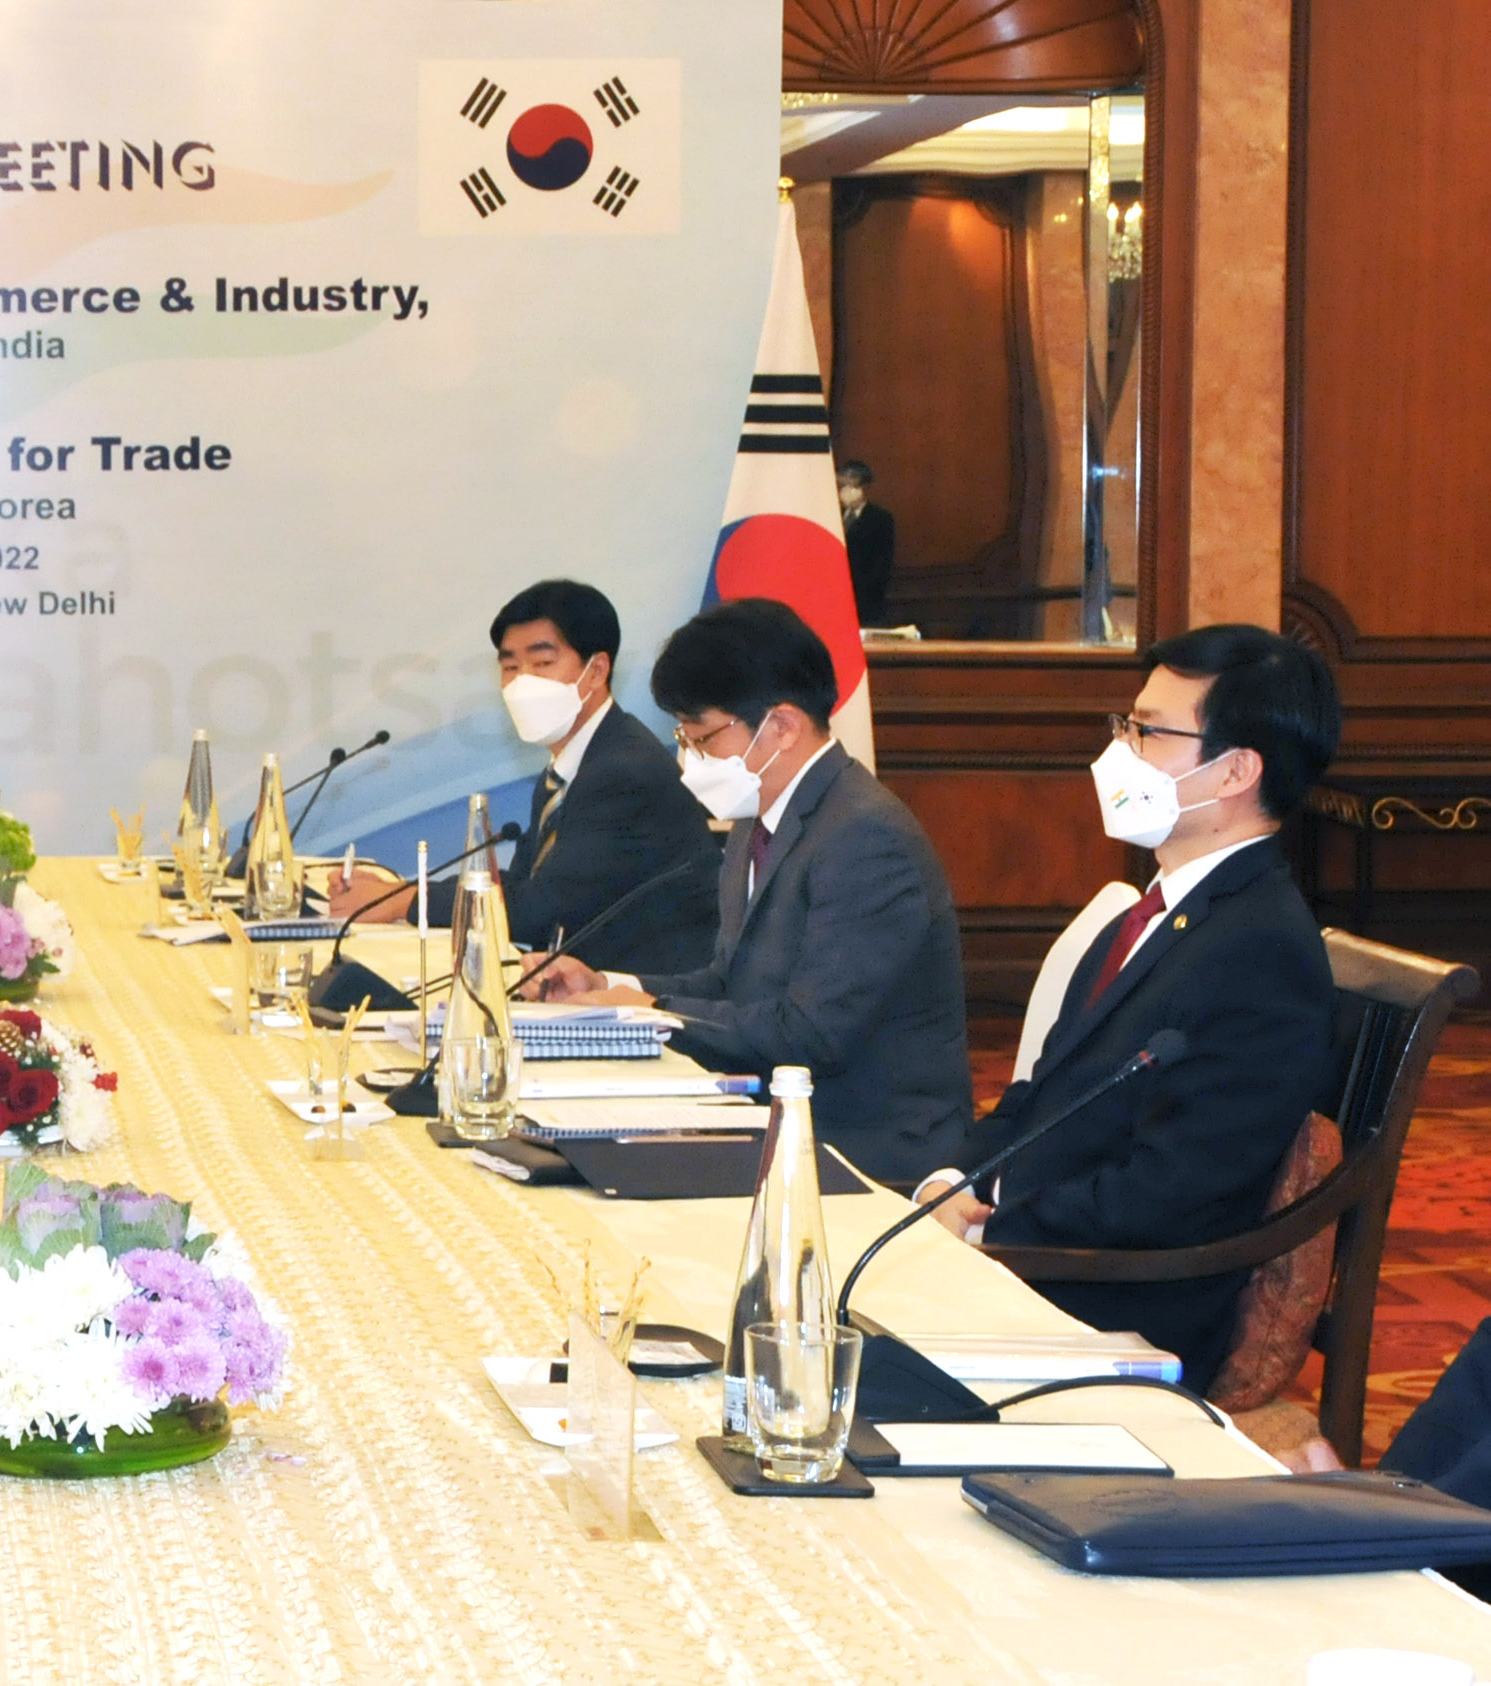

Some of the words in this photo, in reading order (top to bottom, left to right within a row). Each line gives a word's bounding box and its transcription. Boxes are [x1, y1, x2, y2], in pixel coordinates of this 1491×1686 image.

[158, 276, 196, 315] &
[214, 275, 430, 322] Industry,
[6, 435, 77, 474] for
[89, 434, 233, 473] Trade
[36, 589, 117, 618] Delhi
